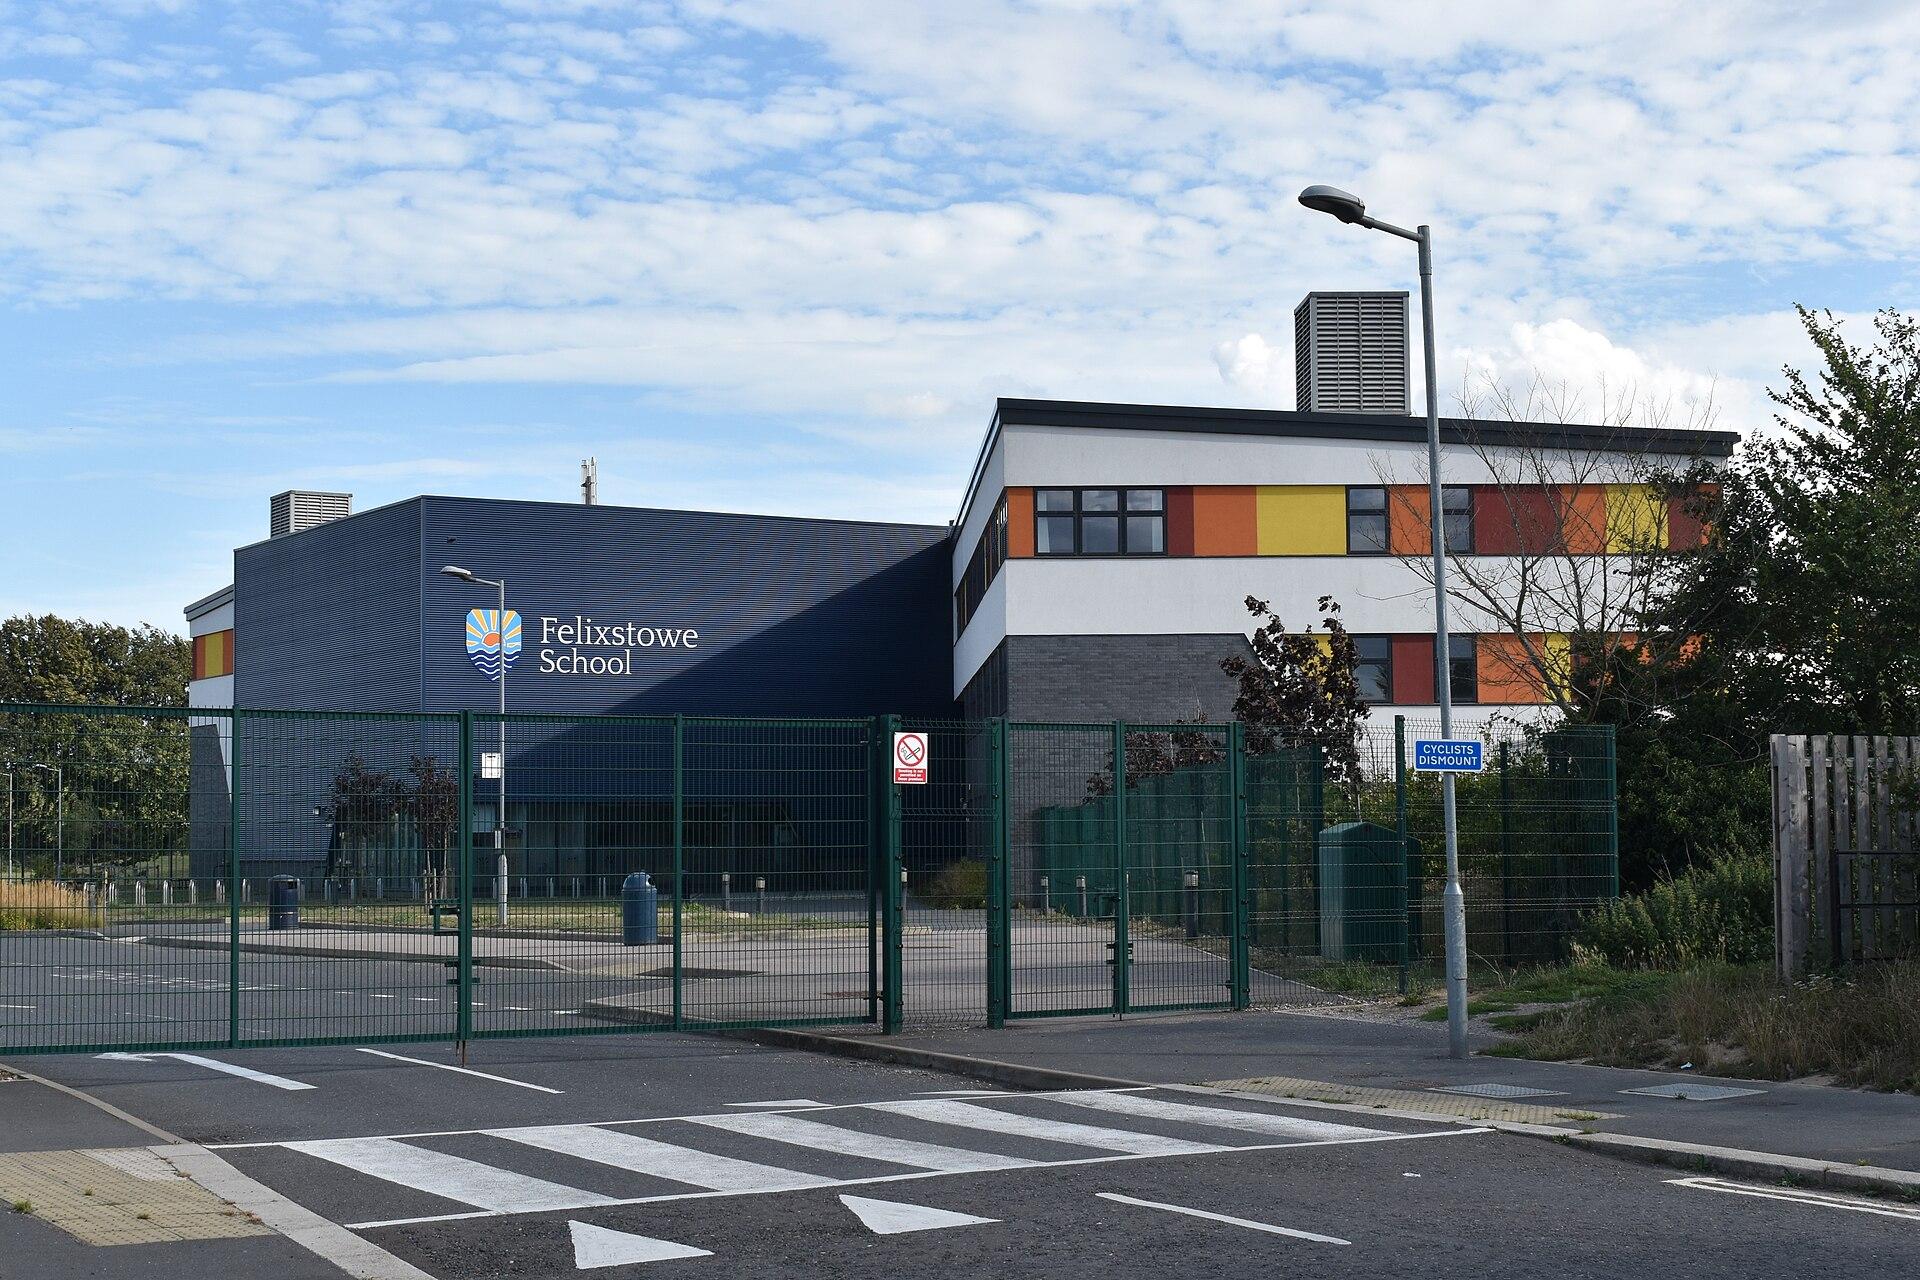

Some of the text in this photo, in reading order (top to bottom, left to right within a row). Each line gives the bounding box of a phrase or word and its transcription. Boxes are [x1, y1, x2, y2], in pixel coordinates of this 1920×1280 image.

[540, 616, 699, 648] Felixstowe
[539, 648, 632, 675] School
[1423, 744, 1474, 755] CYCLISTS
[1419, 755, 1478, 766] DISMOUNT
